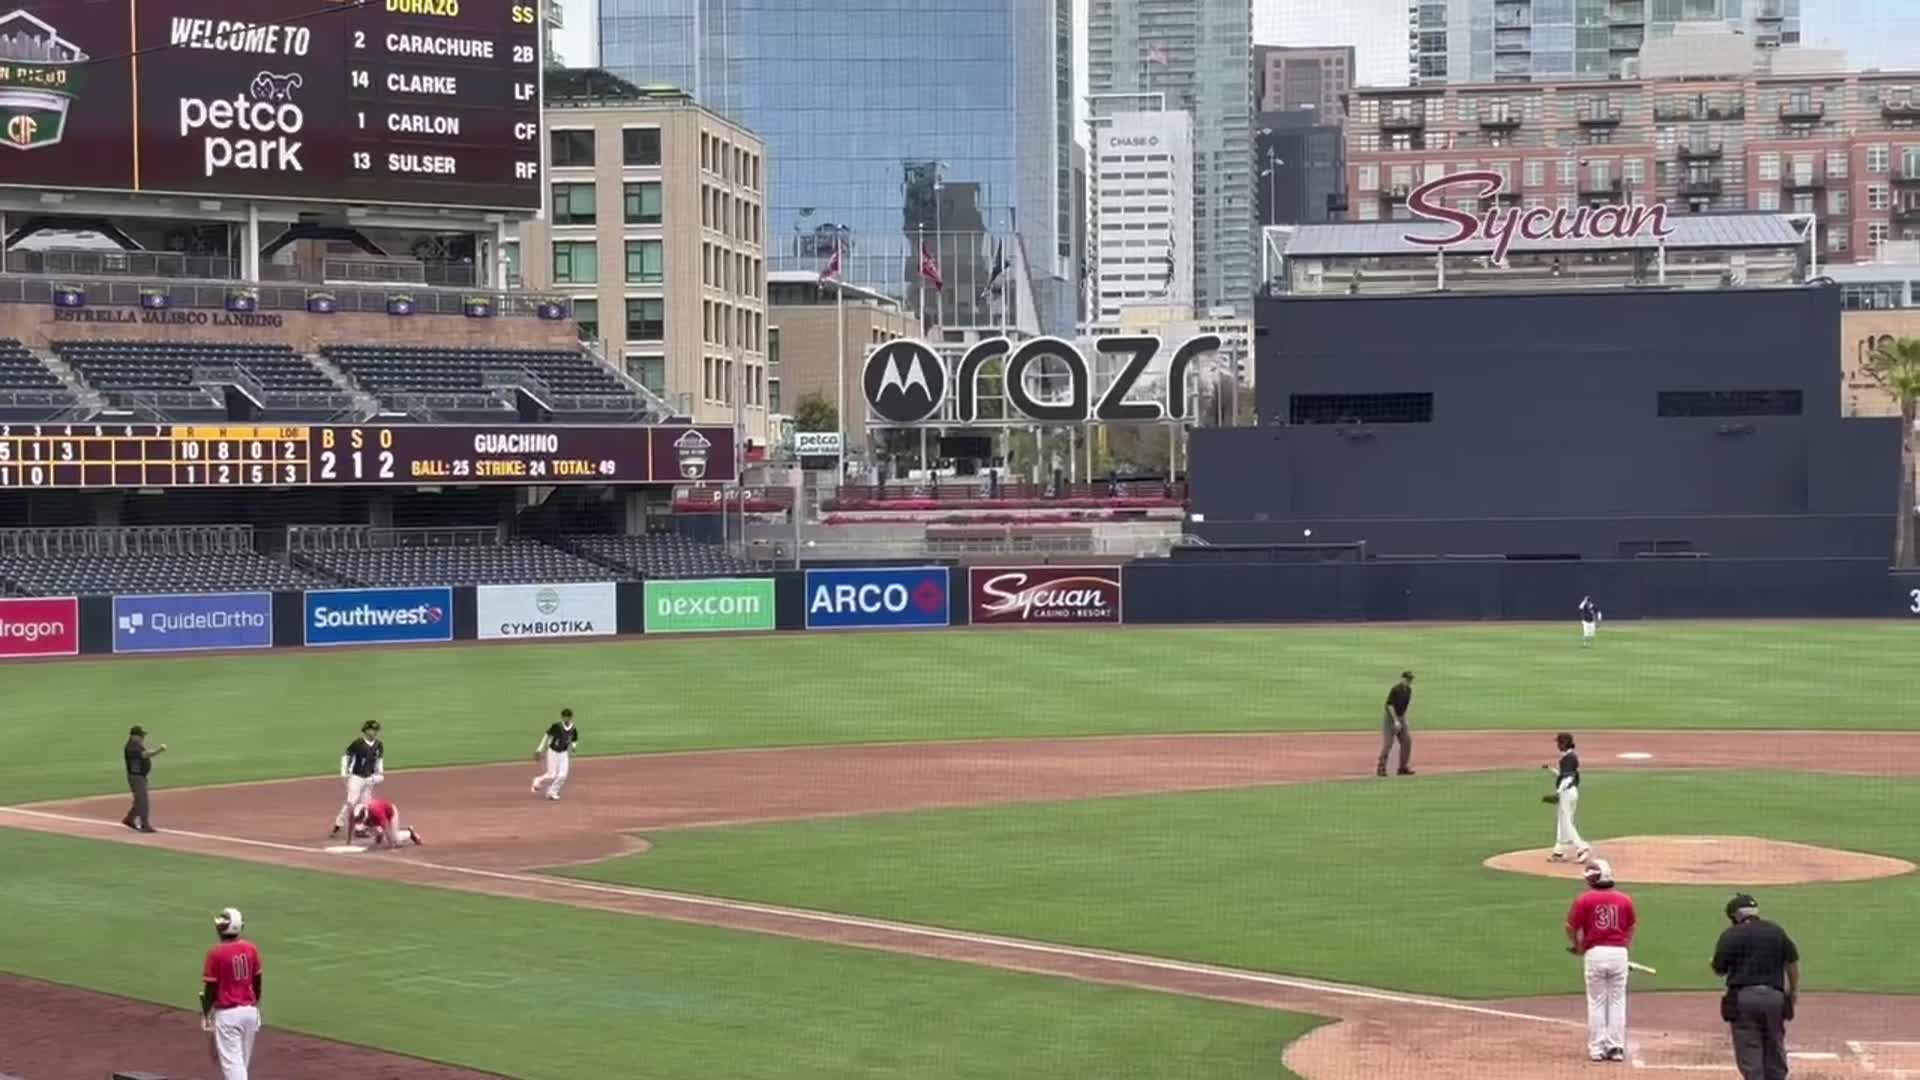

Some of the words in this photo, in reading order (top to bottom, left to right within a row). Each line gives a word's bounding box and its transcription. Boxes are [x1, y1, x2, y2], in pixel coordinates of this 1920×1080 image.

[386, 0, 459, 16] DURAZO
[512, 6, 534, 23] SS
[171, 17, 279, 54] WELCOME
[282, 26, 310, 56] TO
[354, 32, 366, 48] 2
[386, 34, 494, 58] CARACHURE
[512, 46, 534, 62] 2B
[352, 71, 369, 88] 14
[387, 73, 457, 95] CLARKE
[514, 83, 535, 100] LF
[180, 93, 303, 136] petco
[358, 112, 366, 129] 1
[387, 113, 460, 135] CARLON
[514, 123, 537, 139] CF
[205, 136, 303, 176] park
[353, 153, 371, 170] 13
[388, 153, 456, 174] SULSER
[515, 162, 537, 179] RF
[1404, 170, 1675, 264] Sycuan
[53, 309, 137, 324] ESTRELLA
[142, 311, 207, 326] JALISCO
[213, 313, 283, 328] LANDING
[957, 335, 1222, 424] razr
[3, 425, 10, 436] 2
[322, 429, 335, 449] B
[351, 429, 364, 448] S
[380, 429, 392, 448] O
[474, 434, 558, 453] GUACHINO
[0, 442, 10, 460] 5
[33, 442, 40, 460] 1
[62, 442, 72, 460] 3
[182, 441, 199, 459] 10
[218, 442, 229, 460] 8
[251, 441, 263, 459] 0
[284, 441, 296, 459] 2
[2, 467, 9, 485] 1
[31, 467, 43, 485] 0
[187, 466, 194, 484] 1
[218, 466, 230, 484] 2
[251, 466, 263, 484] 5
[285, 466, 296, 484] 3
[321, 451, 336, 479] 2
[352, 451, 362, 479] 1
[379, 451, 395, 479] 2
[411, 460, 450, 476] BALL:
[453, 460, 470, 476] 25
[475, 460, 526, 476] STRIKE:
[529, 460, 546, 476] 24
[552, 460, 595, 475] TOTAL:
[599, 460, 616, 475] 49
[810, 584, 908, 613] ARCO
[981, 573, 1107, 619] Sycuan
[151, 611, 265, 632] QuidelOrtho
[314, 604, 427, 628] Southwest
[1033, 609, 1069, 617] CASINO
[1077, 609, 1111, 617] RESORT
[500, 621, 594, 635] CYMBIOTIKA
[1595, 904, 1618, 930] 31
[232, 953, 249, 981] 11
